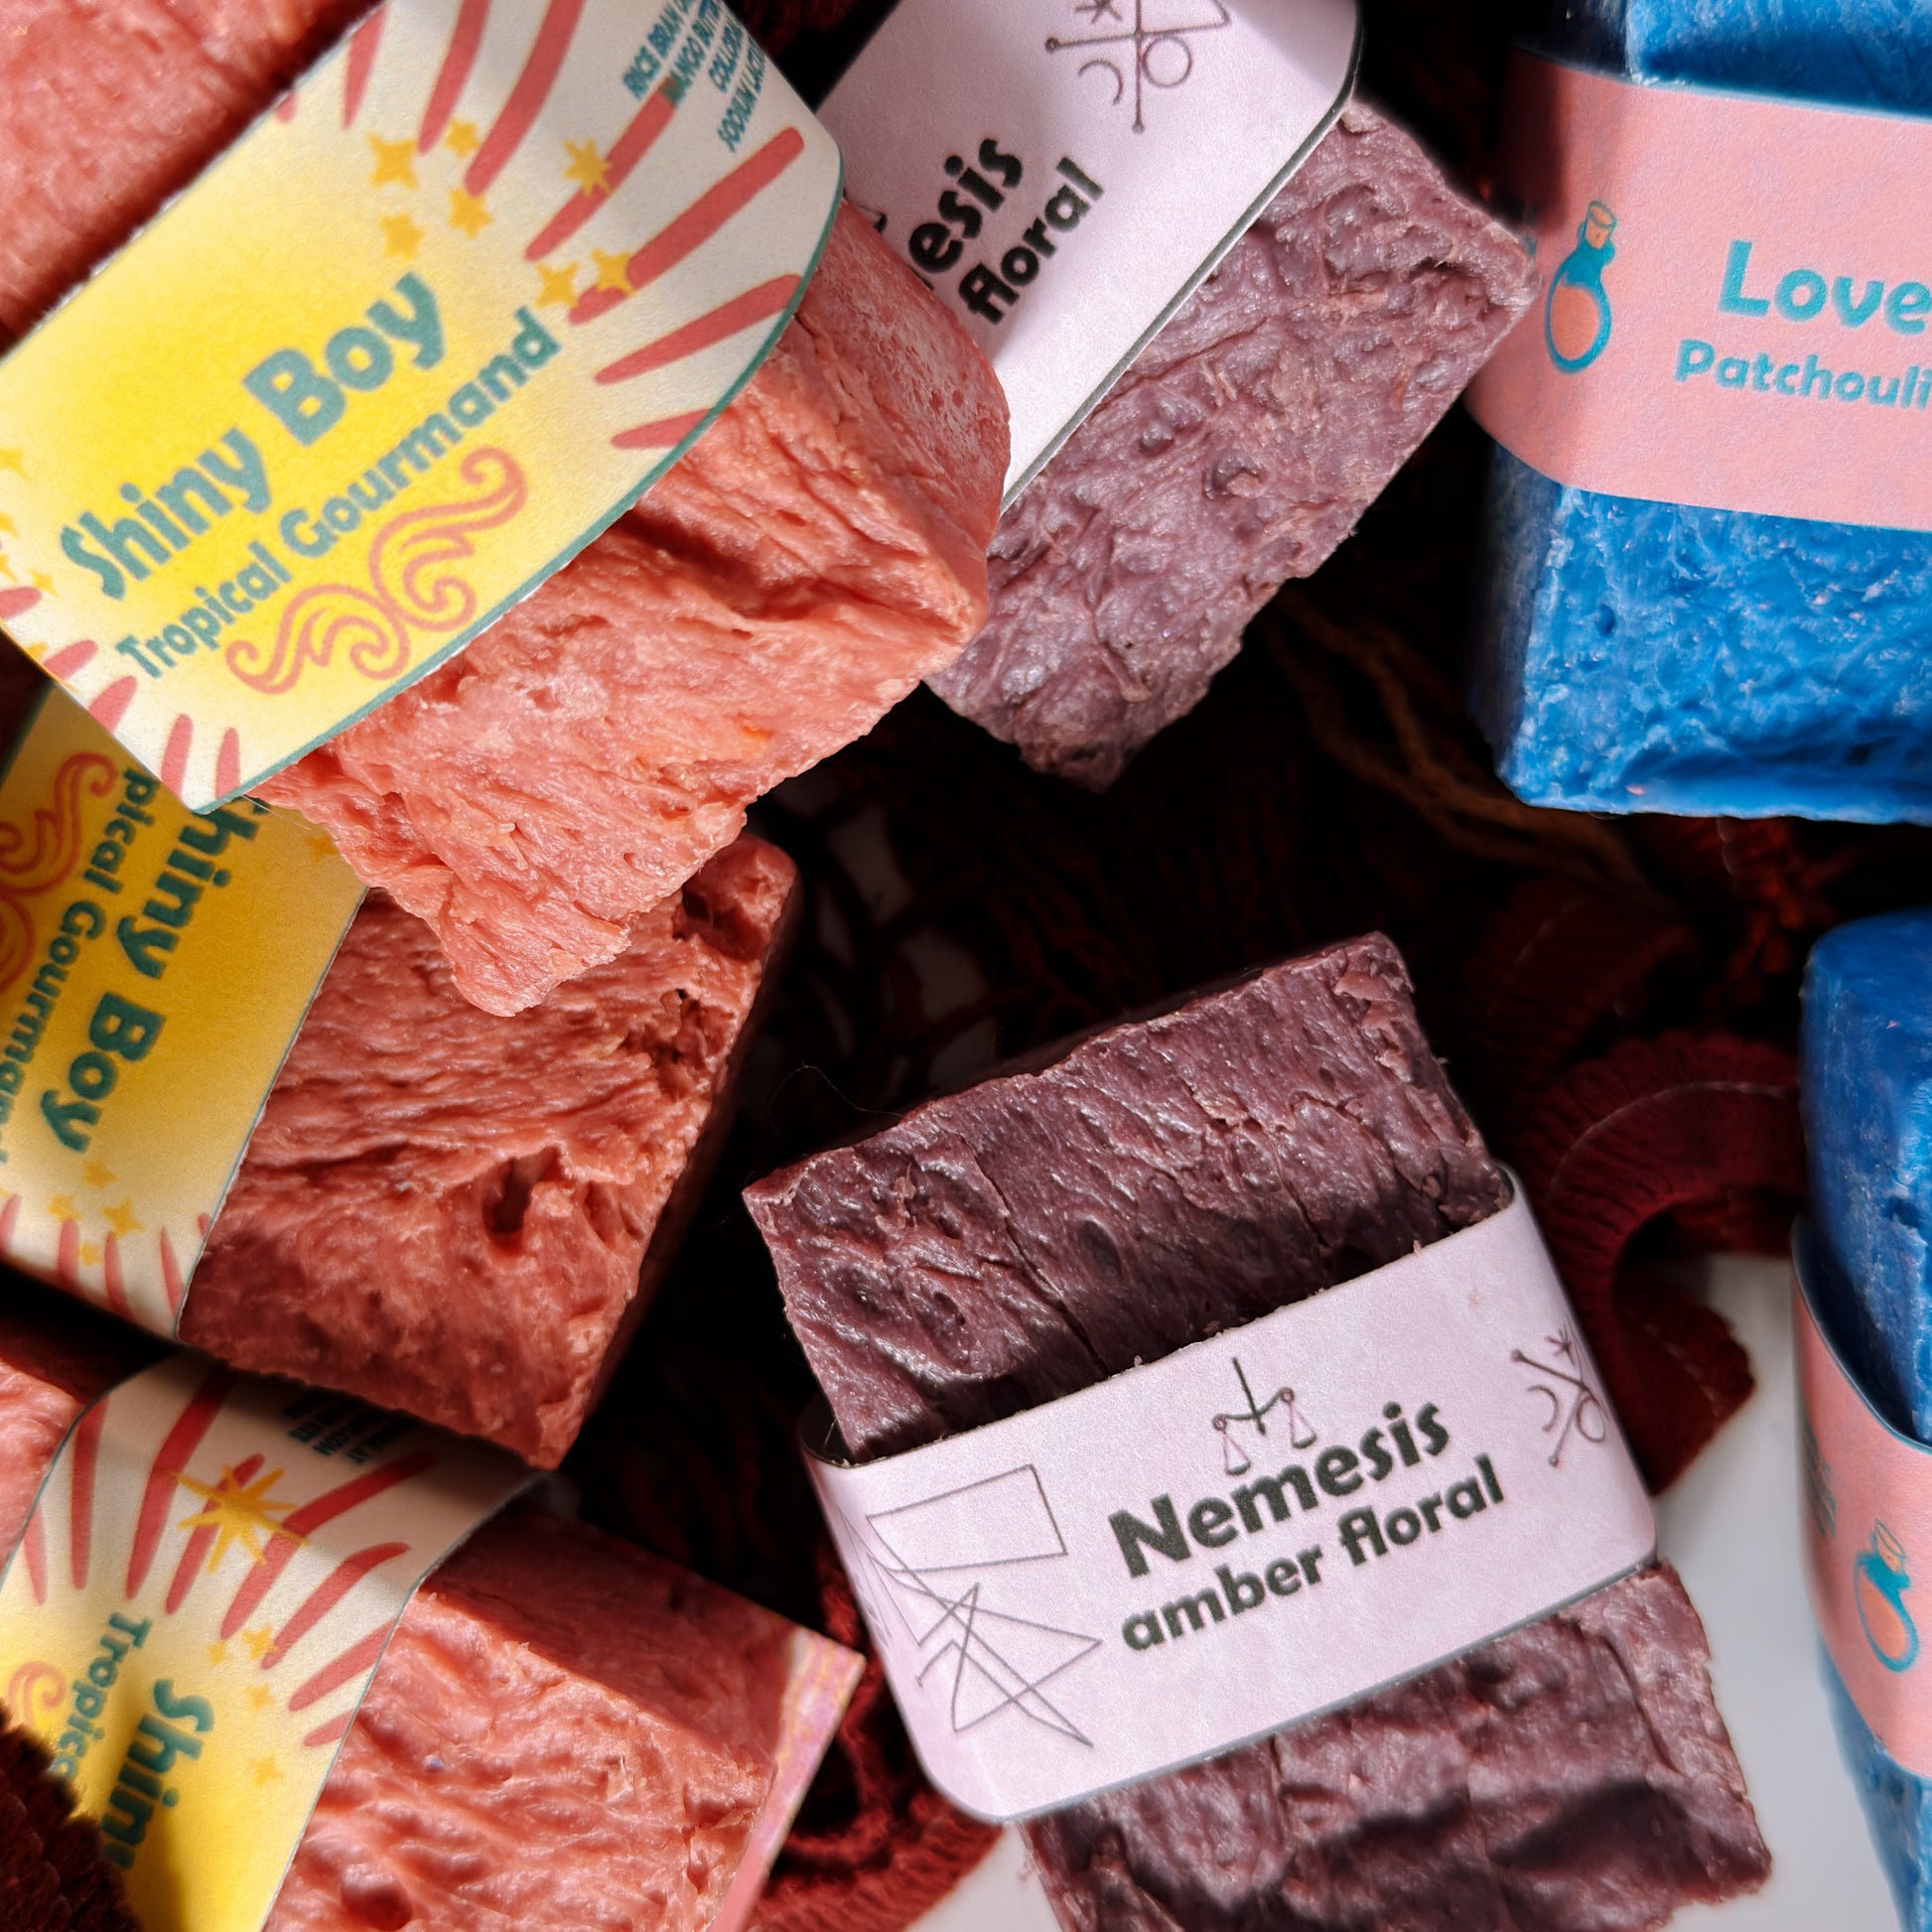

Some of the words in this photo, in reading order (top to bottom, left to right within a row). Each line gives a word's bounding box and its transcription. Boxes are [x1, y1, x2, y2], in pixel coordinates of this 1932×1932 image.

[907, 138, 1023, 286] esis
[959, 156, 1104, 325] floral
[1718, 239, 1932, 335] Love
[60, 427, 272, 601] Shiny
[241, 271, 446, 447] Boy
[115, 539, 293, 679] Tropical
[278, 306, 562, 559] Gourmand
[116, 797, 270, 980] hiny
[0, 899, 104, 1164] Gourma
[40, 992, 166, 1154] Boy
[1108, 1402, 1449, 1579] Nemesis
[1121, 1544, 1324, 1651] amber
[1337, 1452, 1504, 1567] floral
